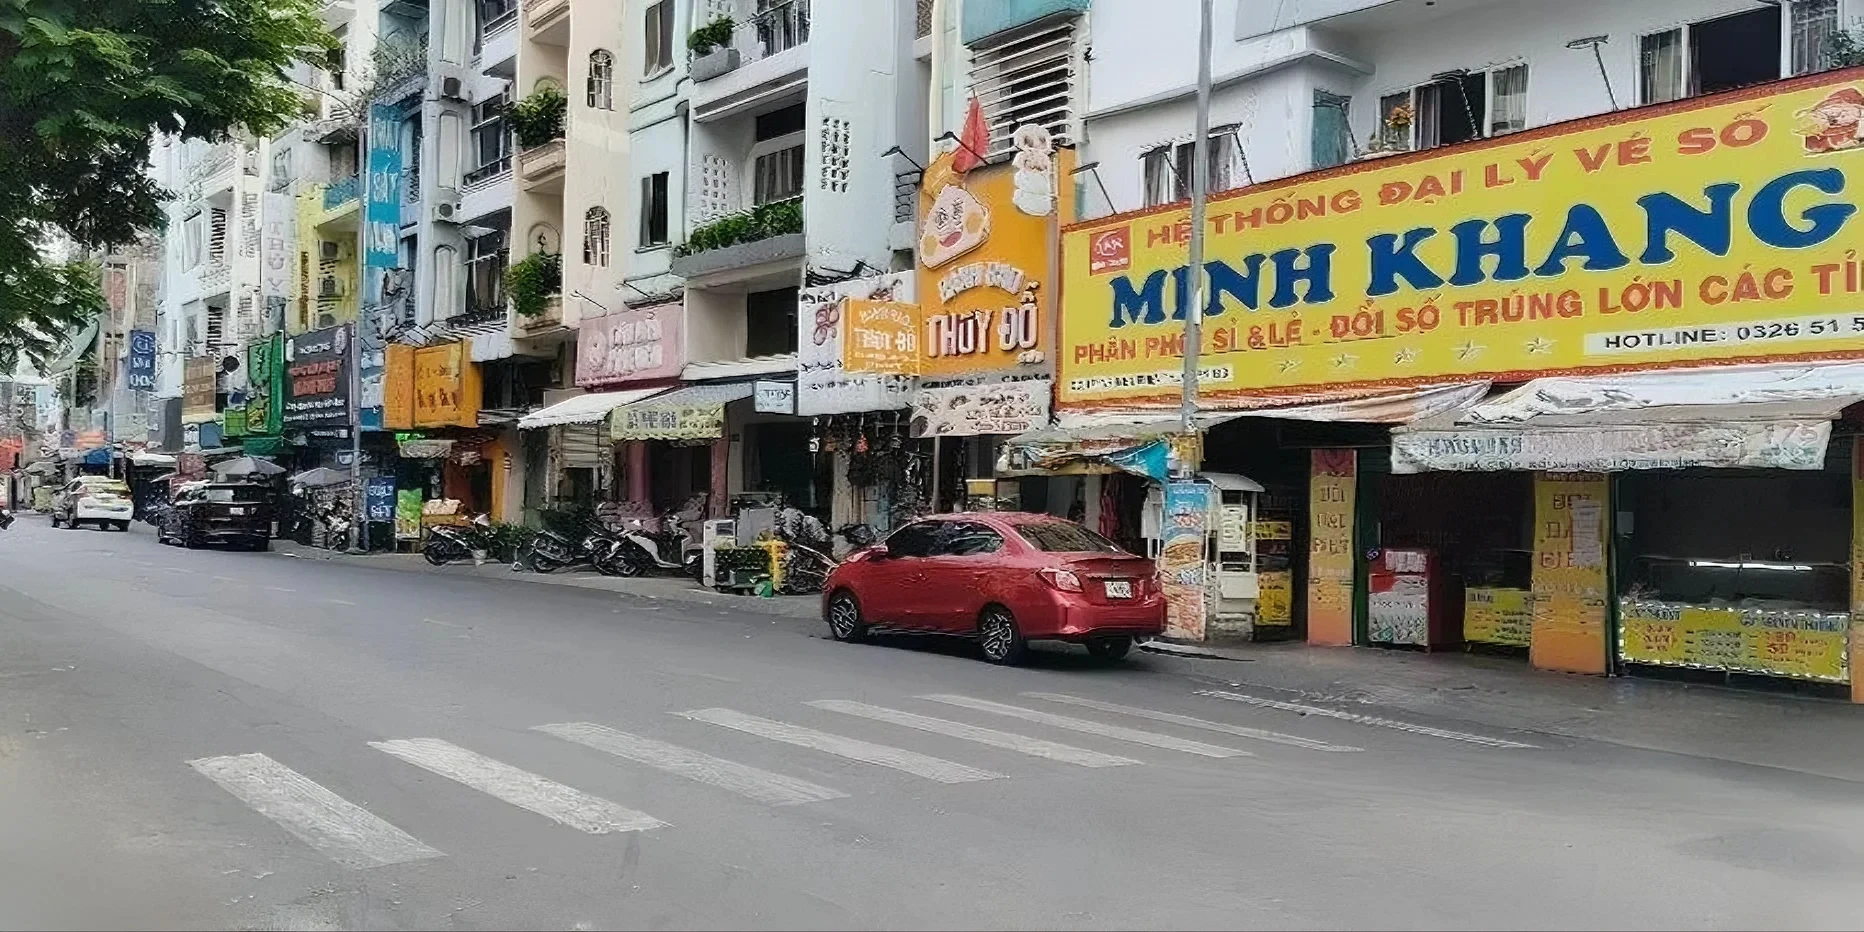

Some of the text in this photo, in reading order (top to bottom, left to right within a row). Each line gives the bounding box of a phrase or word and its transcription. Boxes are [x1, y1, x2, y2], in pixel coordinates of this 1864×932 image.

[1148, 217, 1193, 248] HỆ
[1206, 191, 1363, 235] THỐNG
[1378, 170, 1464, 206] ĐẠI
[1485, 145, 1555, 190] LÝ
[1574, 131, 1653, 173] VÉ
[1678, 103, 1773, 155] SỐ
[1074, 336, 1136, 365] PHÂN
[1330, 298, 1384, 338] ĐỔI
[1395, 293, 1443, 333] SỐ
[1453, 289, 1583, 327] TRÚNG
[1599, 276, 1682, 316] LỚN
[1699, 263, 1794, 305] CÁC
[1811, 249, 1864, 296] TỈ
[1109, 168, 1859, 328] MINH KHANG
[1605, 329, 1727, 349] HOTLINE:
[1737, 323, 1799, 341] 0326
